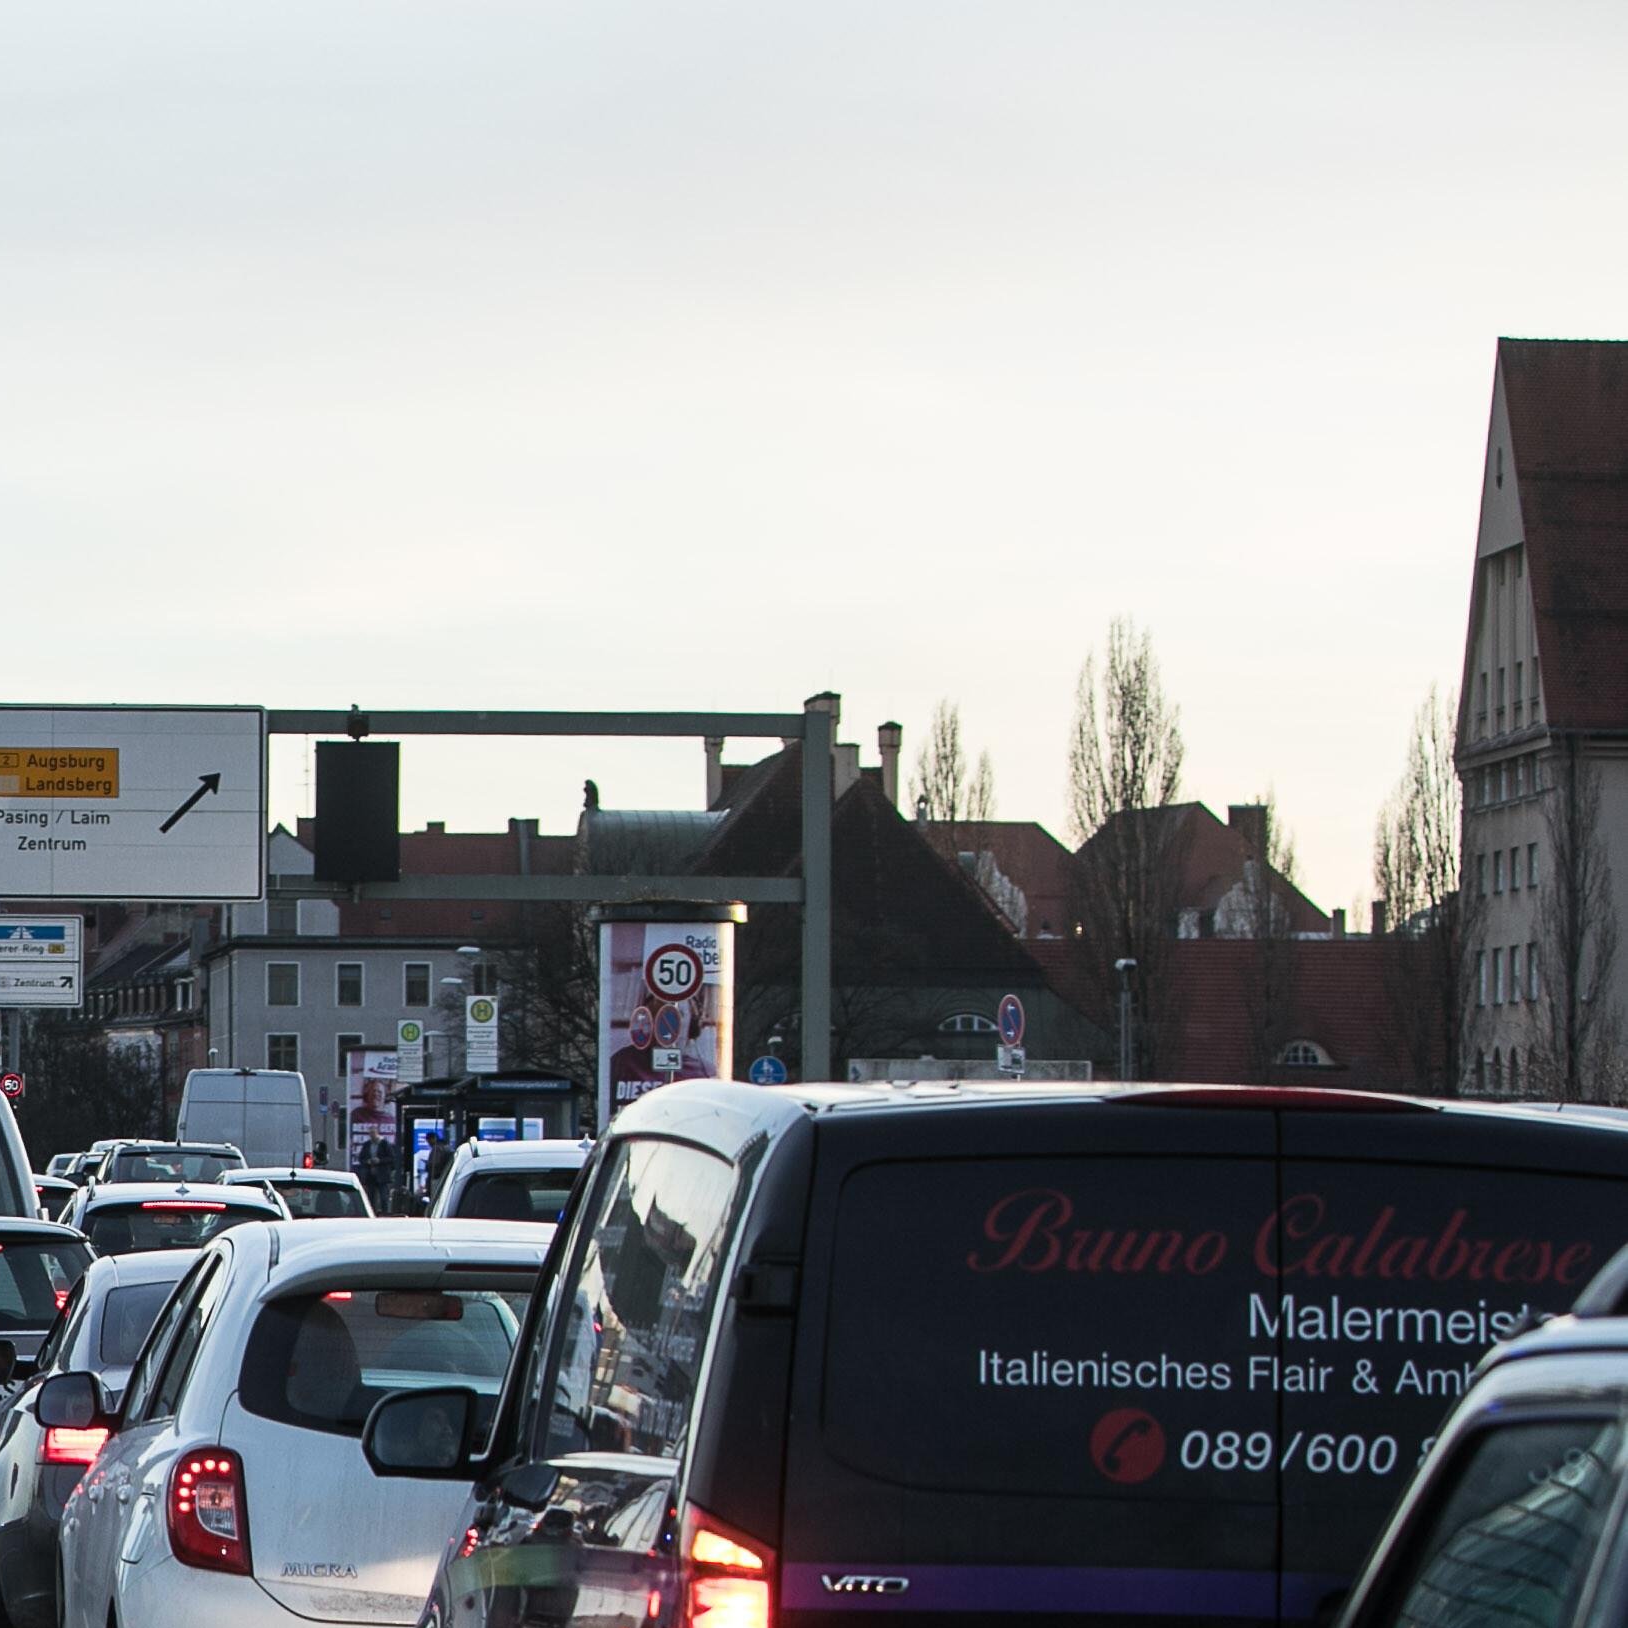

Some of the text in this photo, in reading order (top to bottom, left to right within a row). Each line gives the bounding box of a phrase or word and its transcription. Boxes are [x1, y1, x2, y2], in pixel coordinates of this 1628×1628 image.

[3, 754, 105, 771] 2 Augsburg
[26, 777, 112, 794] Landsberg
[71, 810, 110, 824] Laim
[18, 836, 86, 850] Zentrum
[23, 944, 45, 955] Ring
[686, 935, 717, 949] Radio
[658, 959, 692, 986] 50
[14, 978, 55, 987] Zentrum
[4, 1079, 19, 1091] 50
[967, 1188, 1594, 1285] Bruno Calabrese
[1248, 1293, 1558, 1344] Malermeis
[978, 1349, 1232, 1391] Italienisches
[1248, 1355, 1333, 1394] Flair
[1351, 1359, 1380, 1395] &
[1180, 1430, 1398, 1475] 089/600
[280, 1561, 358, 1579] MICRA
[821, 1574, 910, 1593] VITO
